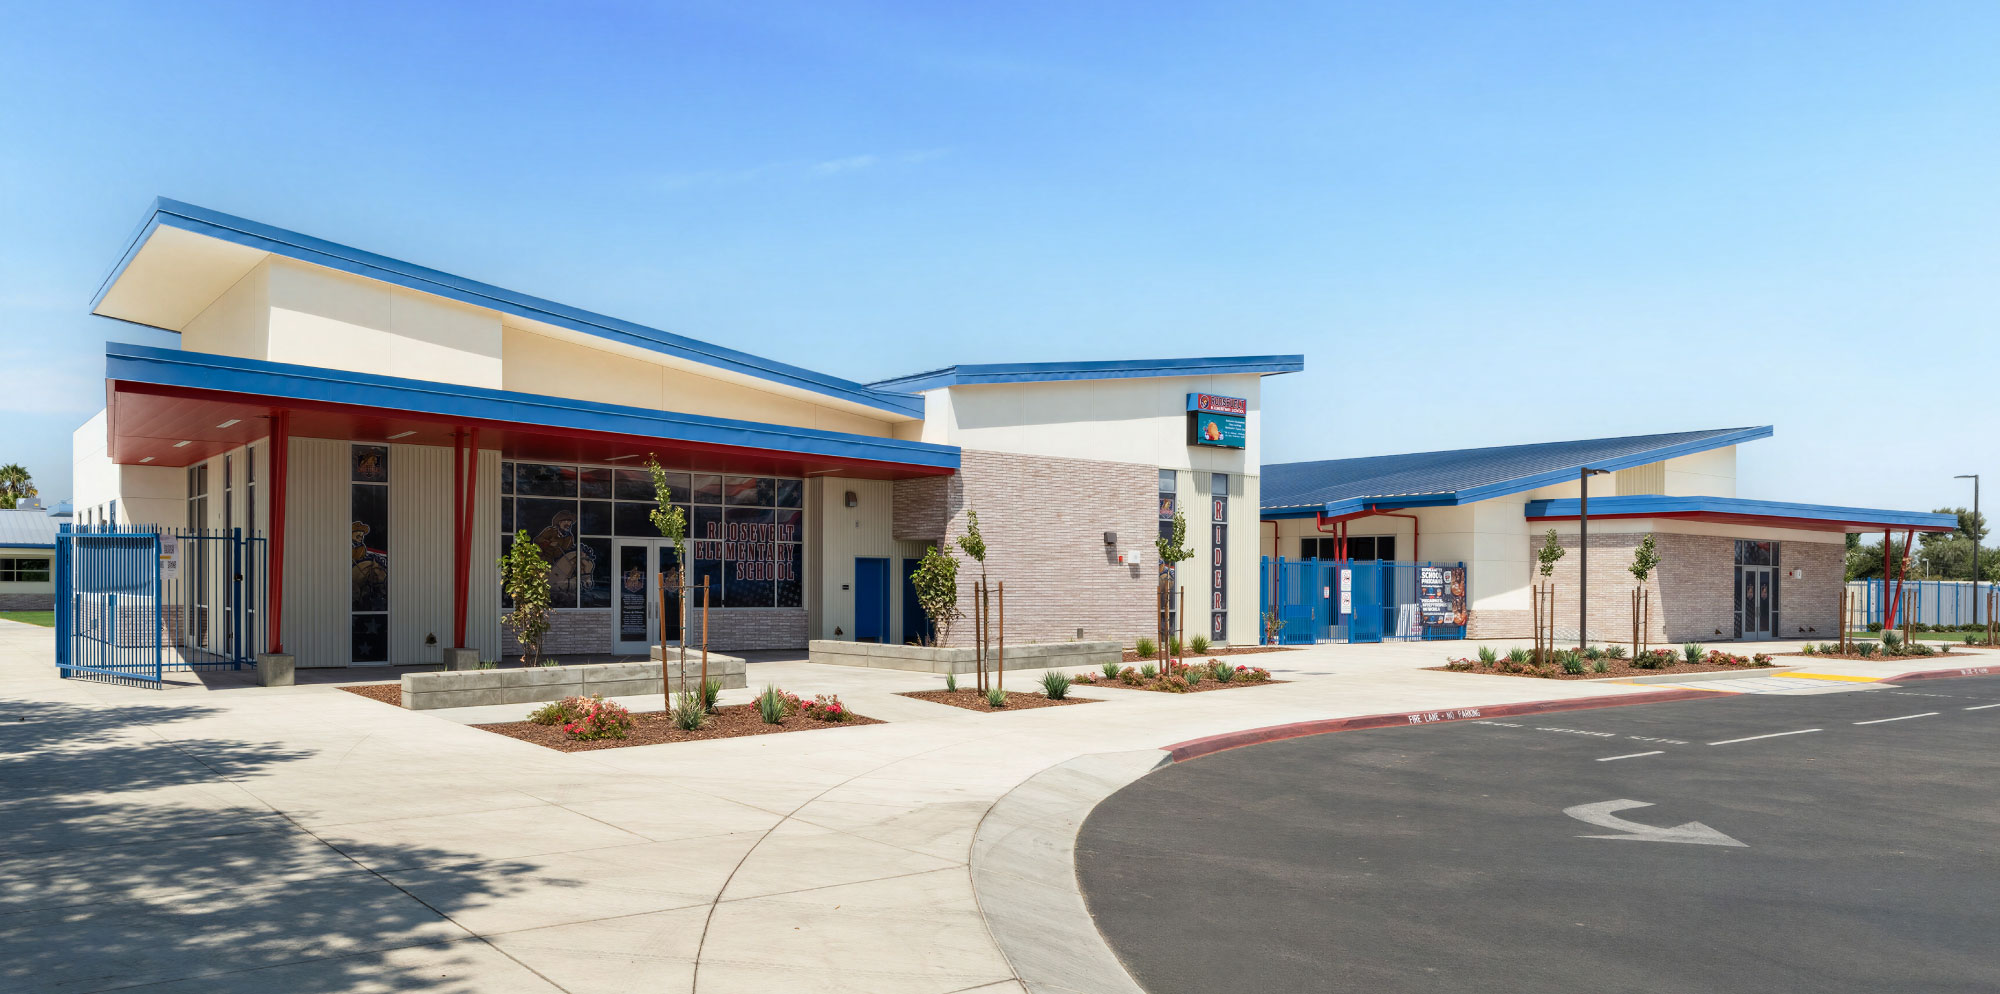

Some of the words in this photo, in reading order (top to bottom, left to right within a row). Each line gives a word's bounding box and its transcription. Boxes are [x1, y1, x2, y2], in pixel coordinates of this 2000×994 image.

[1211, 397, 1244, 409] ROOSEVELT
[707, 522, 795, 542] ROOSEVELT
[695, 541, 795, 561] ELEMENTARY
[736, 561, 795, 580] SCHOOL
[1214, 500, 1222, 632] RIDERS
[1408, 714, 1422, 724] FIRE
[1424, 712, 1440, 723] LANE
[1446, 711, 1455, 720] NO
[1457, 709, 1481, 719] PARKING
